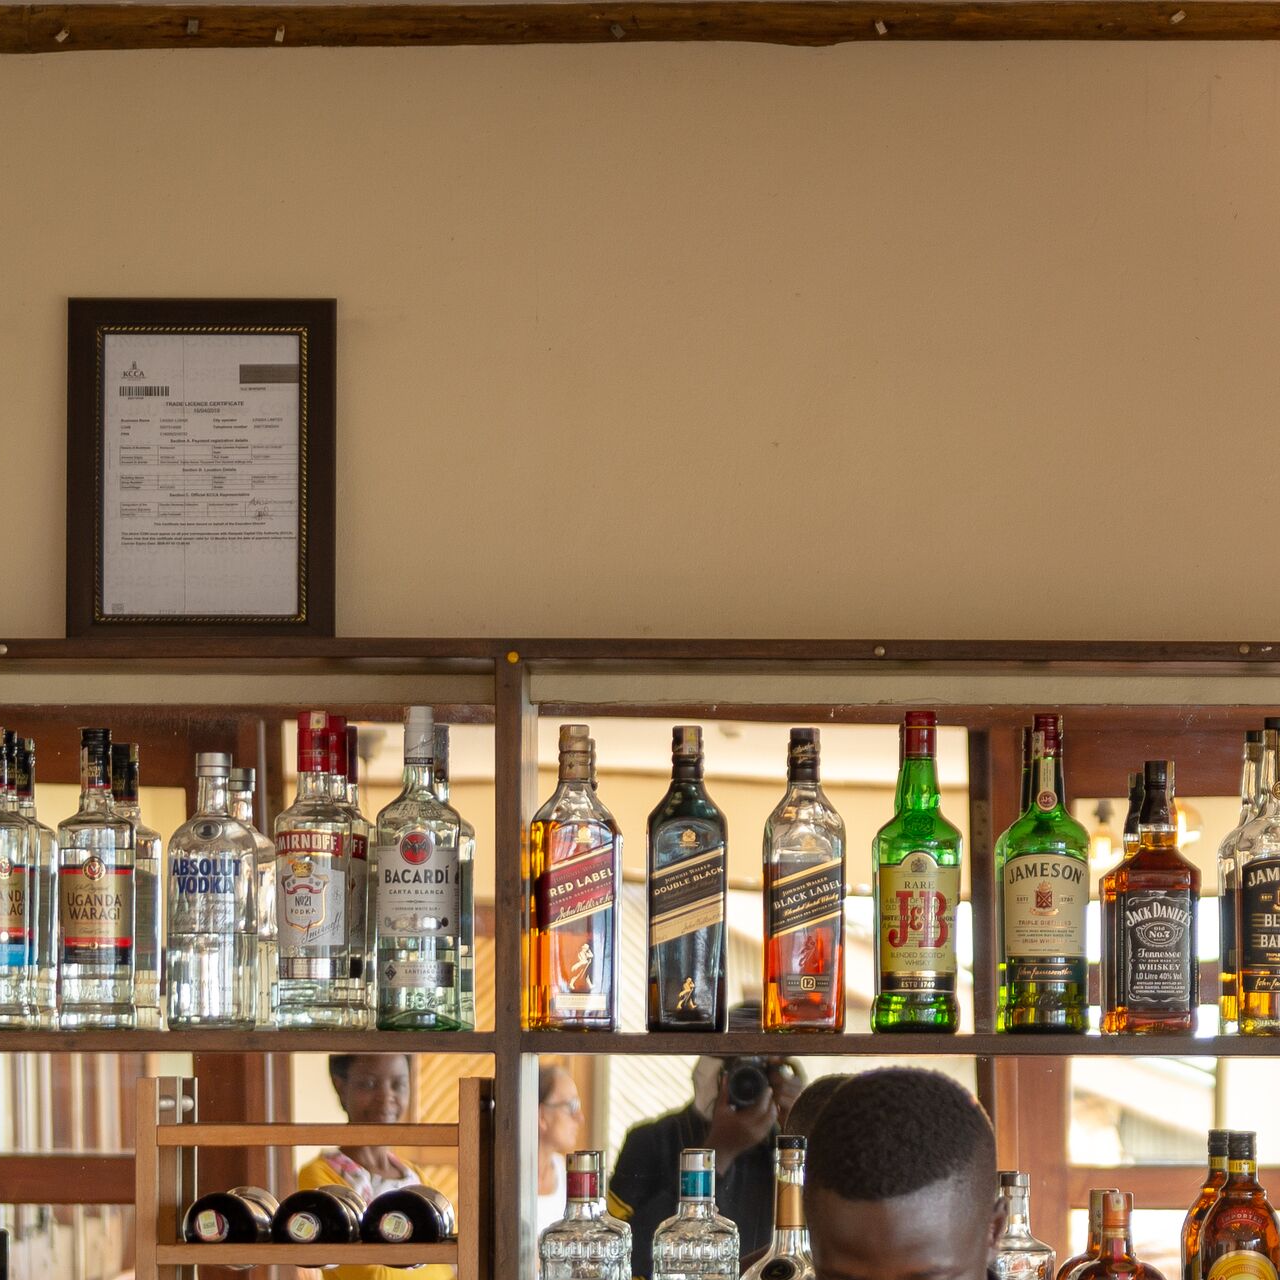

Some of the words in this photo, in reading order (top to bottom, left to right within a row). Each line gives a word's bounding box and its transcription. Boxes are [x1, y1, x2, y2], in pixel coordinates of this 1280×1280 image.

[172, 858, 242, 876] ABSOLUT
[1009, 862, 1083, 885] JAMESON
[177, 877, 235, 894] VODKA
[549, 883, 574, 897] RED
[577, 867, 613, 889] LABEL
[654, 878, 691, 896] DOUBLE
[693, 866, 724, 882] BLACK
[904, 881, 935, 889] RARE
[67, 892, 122, 907] UGANDA
[773, 892, 808, 910] BLACK
[809, 879, 842, 897] LABEL
[70, 908, 121, 921] WARAGI
[1125, 905, 1152, 927] JACK
[1148, 930, 1170, 938] No.7
[1137, 948, 1181, 958] Tennessee
[1138, 963, 1181, 971] WHISKEY
[803, 977, 814, 989] 12
